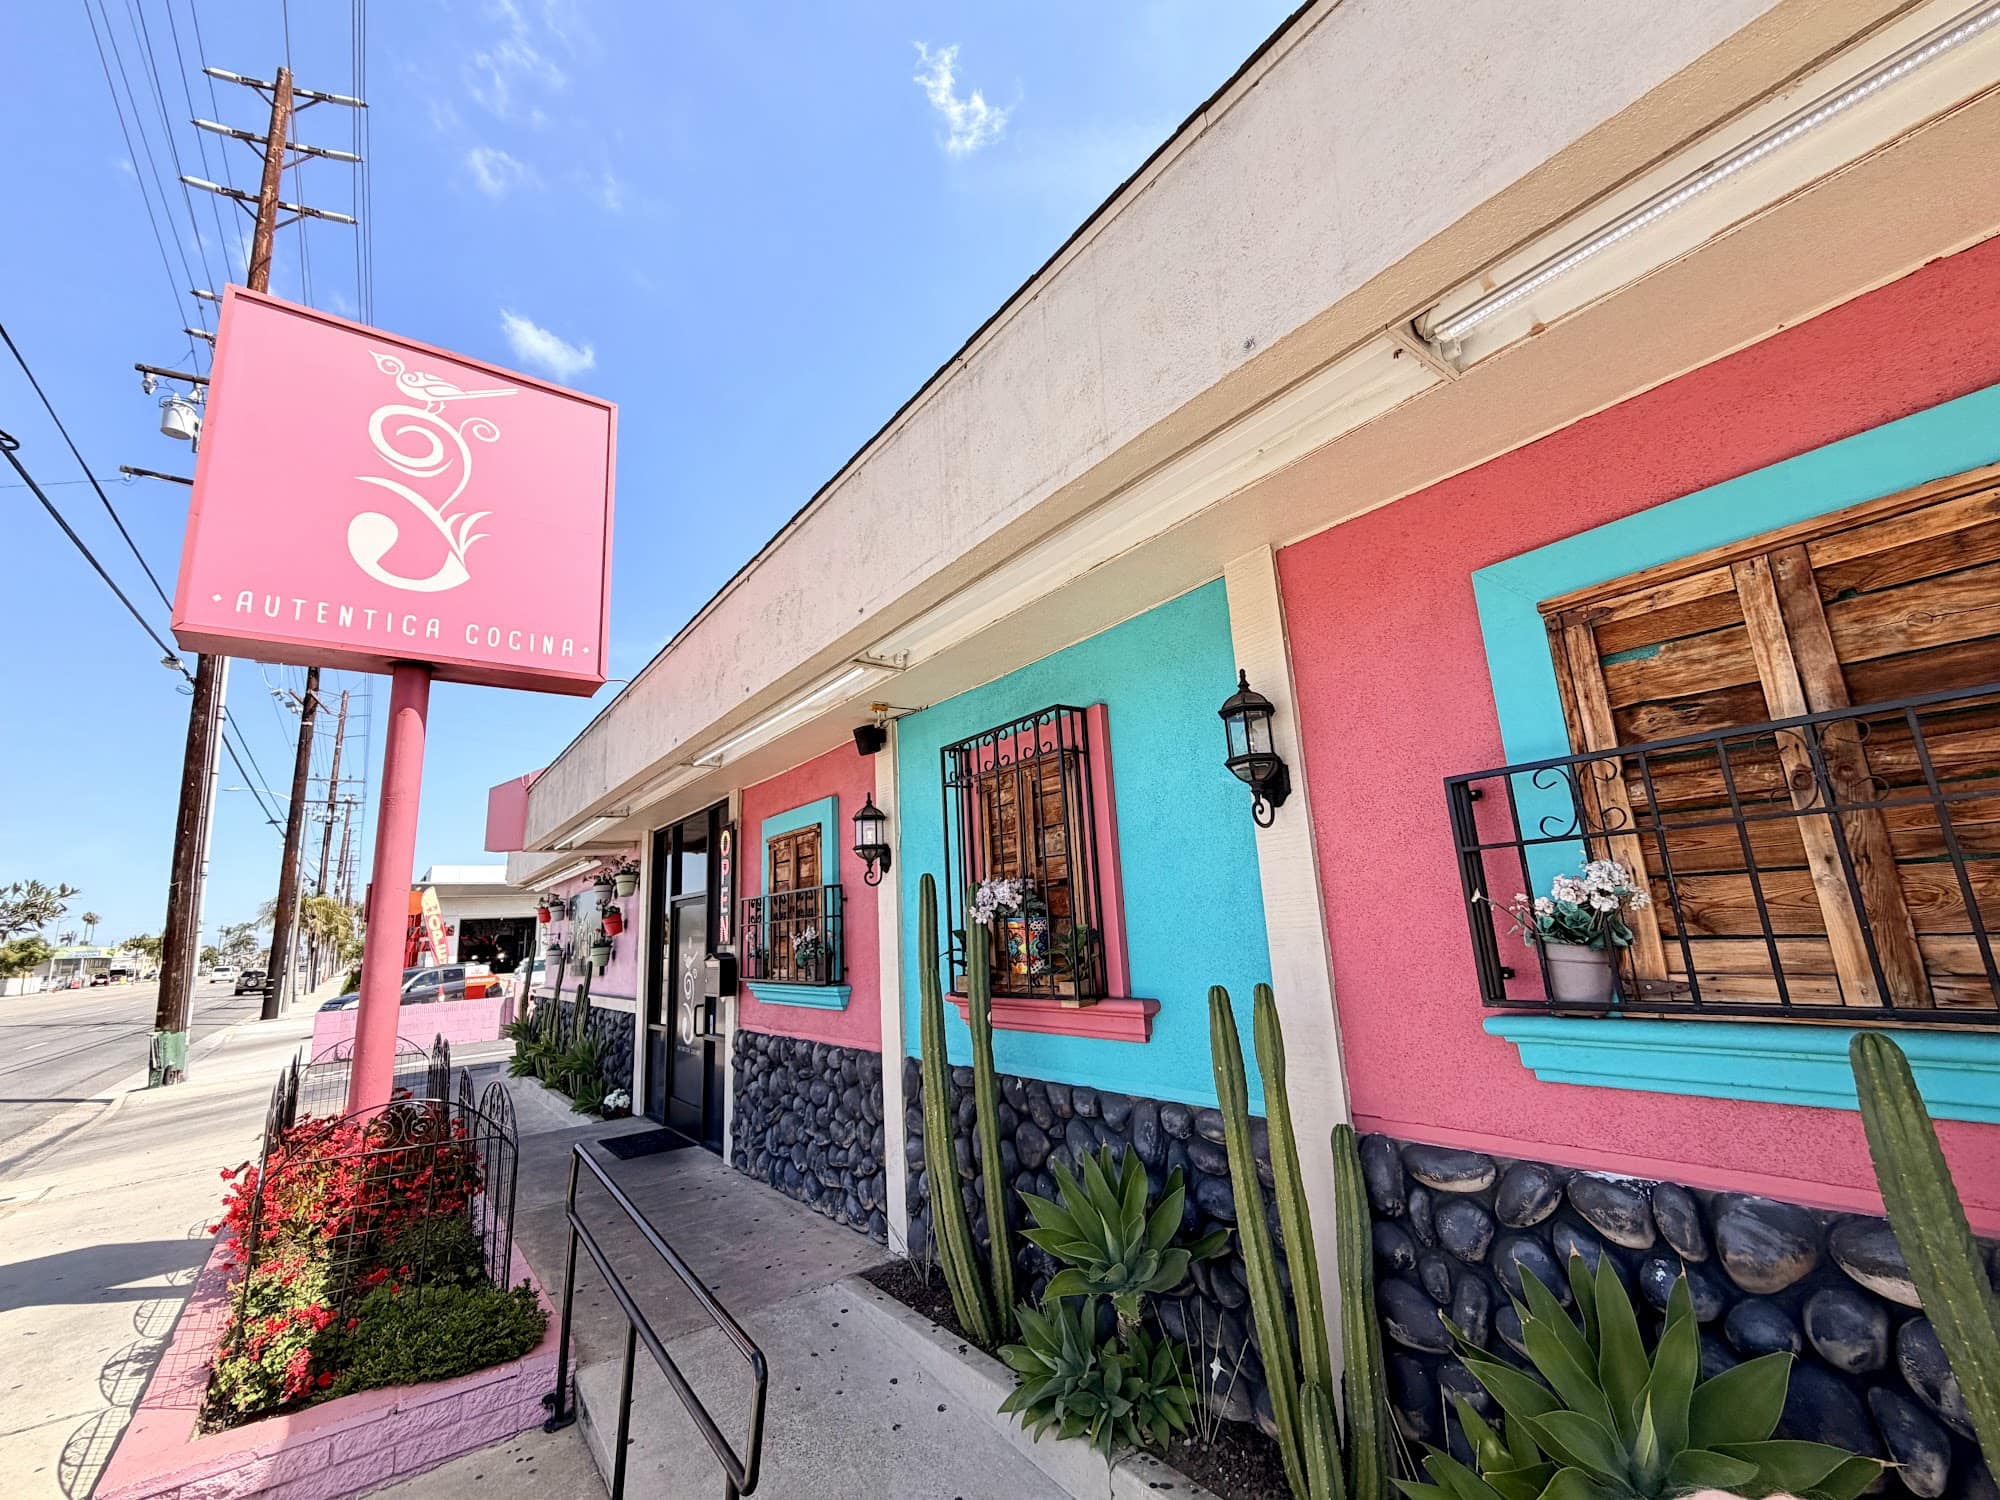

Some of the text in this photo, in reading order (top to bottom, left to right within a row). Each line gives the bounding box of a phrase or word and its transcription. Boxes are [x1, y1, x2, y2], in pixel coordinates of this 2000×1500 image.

[235, 590, 574, 657] AUTENTICA COCINA
[719, 830, 731, 943] OPEN
